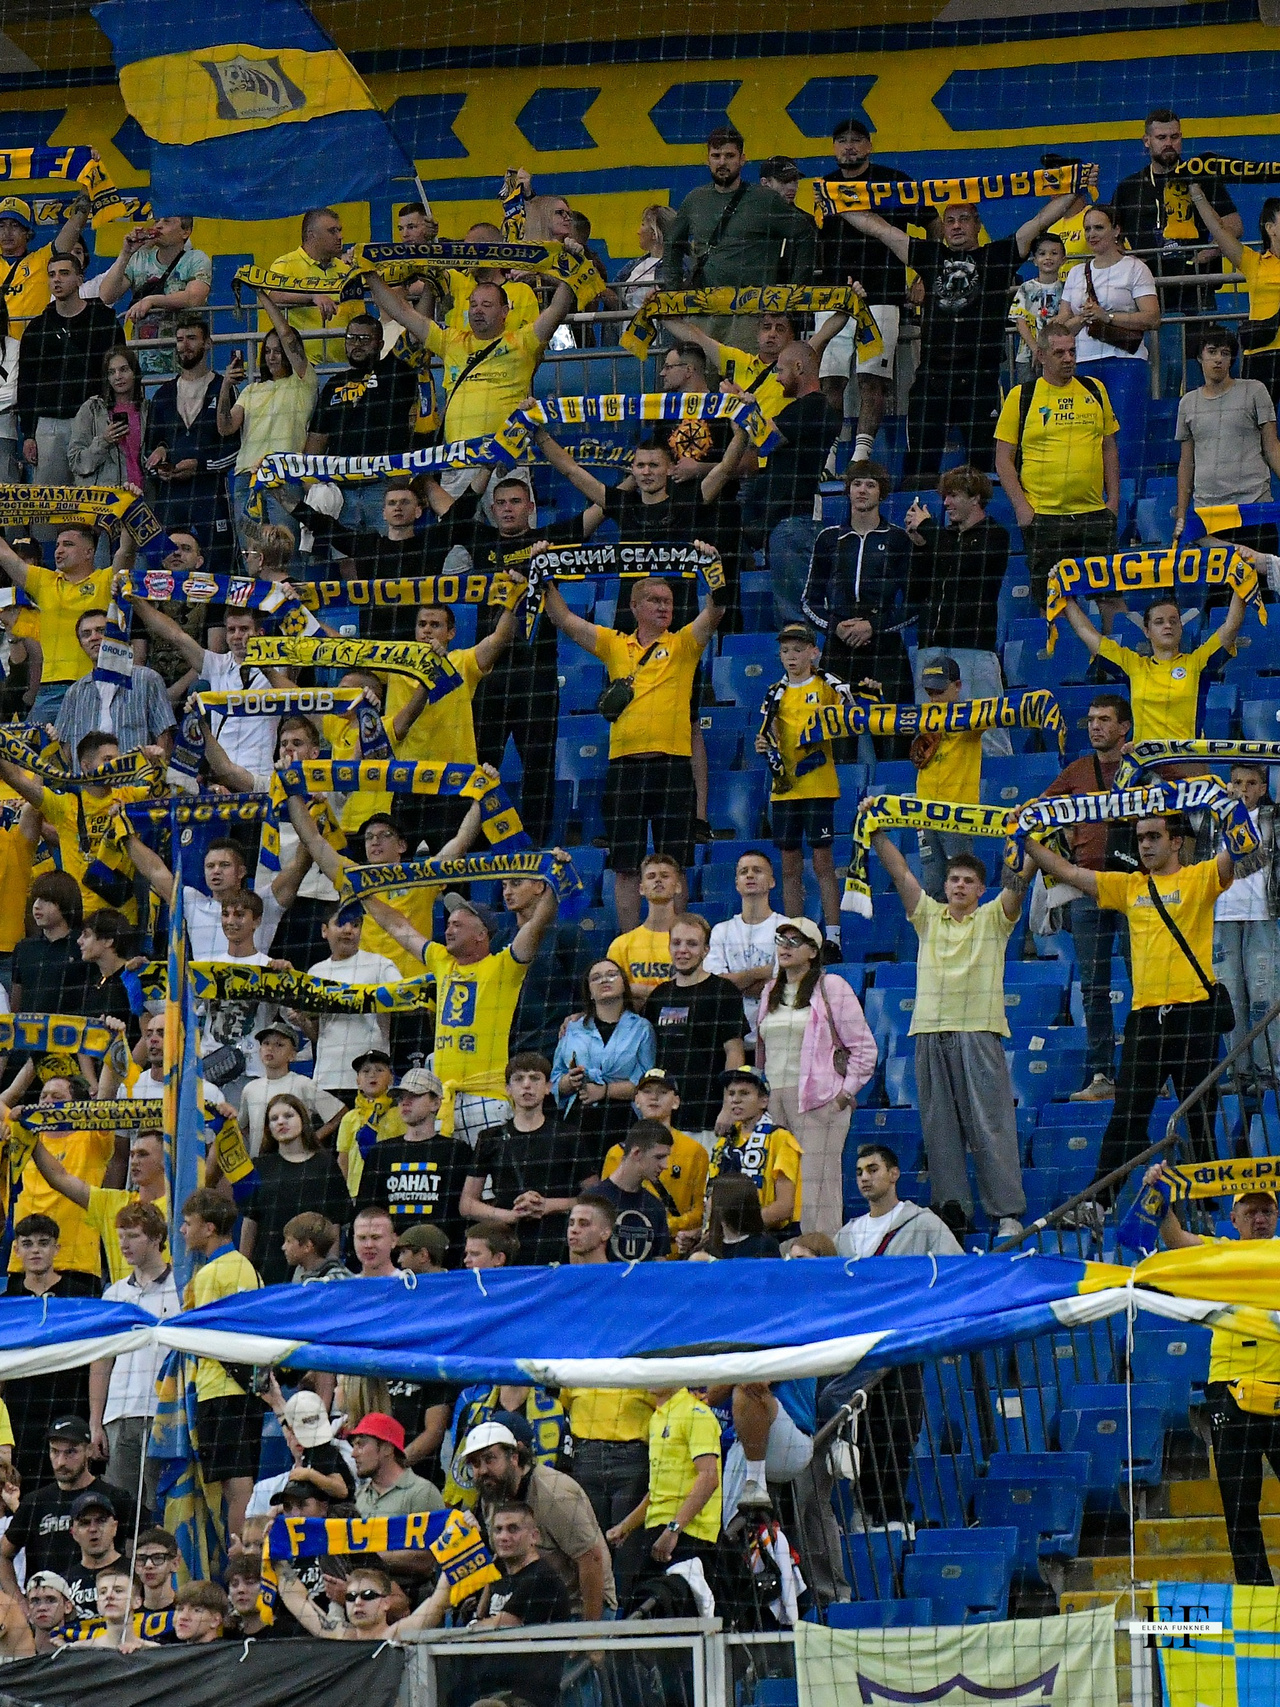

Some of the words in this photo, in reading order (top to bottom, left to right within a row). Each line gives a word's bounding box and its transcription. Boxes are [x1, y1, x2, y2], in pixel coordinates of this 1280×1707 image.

[870, 172, 1032, 207] РОСТОВ
[670, 393, 740, 415] 1930
[1057, 397, 1074, 405] FON
[257, 452, 391, 484] СТОЛИЦА
[402, 441, 466, 470] ЮГА
[1057, 547, 1229, 591] РОСТОВ
[320, 574, 487, 605] РОСТОВ
[102, 643, 128, 659] GROUP
[225, 690, 335, 715] РОСТОВ
[1017, 787, 1166, 832] СТОЛИЦА
[1177, 780, 1239, 821] ЮГА
[361, 867, 403, 888] АЗОВ
[410, 863, 433, 878] ЗА
[439, 853, 544, 877] СЕЛЬМАШ
[386, 1174, 441, 1193] ФАНАТ
[1194, 1165, 1234, 1184] ФК
[448, 1552, 488, 1583] 1930
